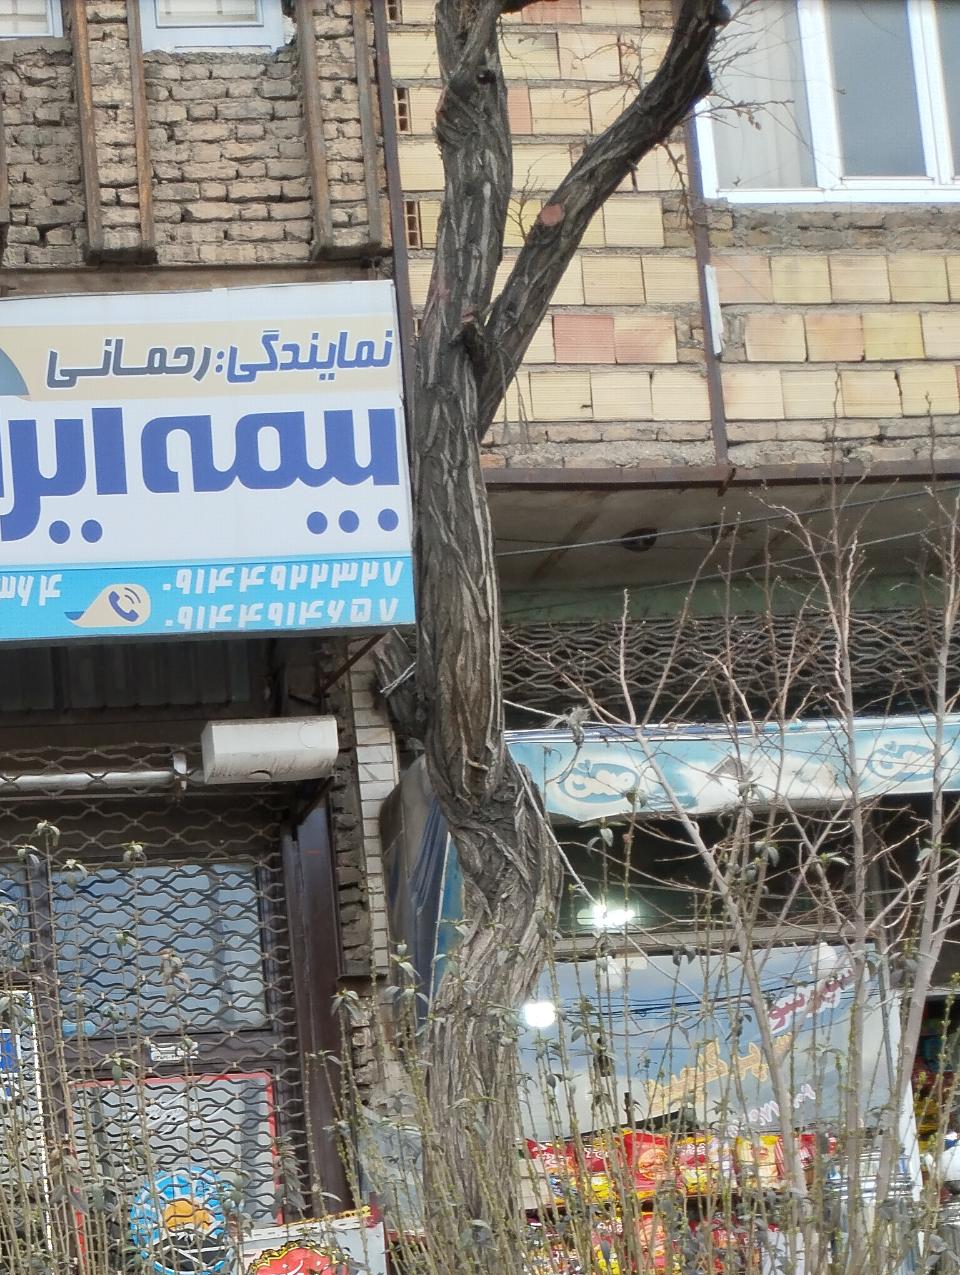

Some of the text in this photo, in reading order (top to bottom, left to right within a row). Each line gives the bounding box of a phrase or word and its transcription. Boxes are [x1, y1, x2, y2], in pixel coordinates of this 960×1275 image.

[46, 329, 394, 389] نمایندگی: رحمانی
[140, 407, 400, 535] بیمه
[162, 560, 404, 595] ۰۹۱۴۴۹۲۲۳۲۷
[164, 597, 400, 630] ۰۹۱۴۴۹۱۴۶۵۷
